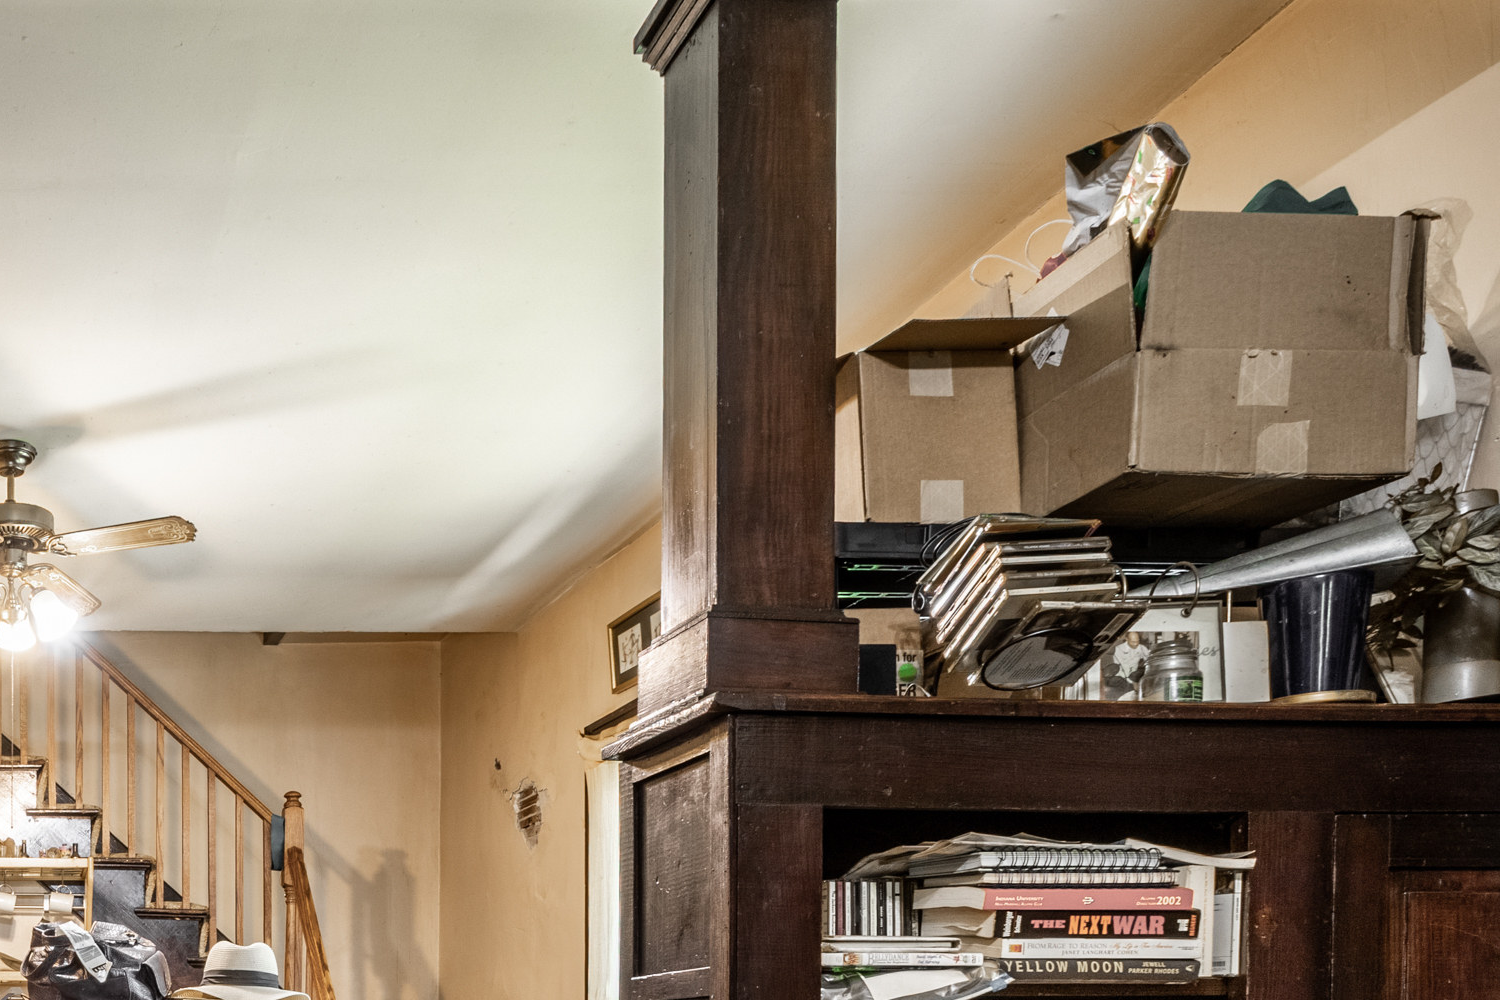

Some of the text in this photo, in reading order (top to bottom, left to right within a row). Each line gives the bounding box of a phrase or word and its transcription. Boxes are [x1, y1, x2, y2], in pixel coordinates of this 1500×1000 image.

[902, 652, 917, 663] for
[1156, 896, 1182, 906] 2002
[1030, 915, 1166, 935] THE NEXT WAR
[1004, 961, 1124, 974] YELLOW MOON
